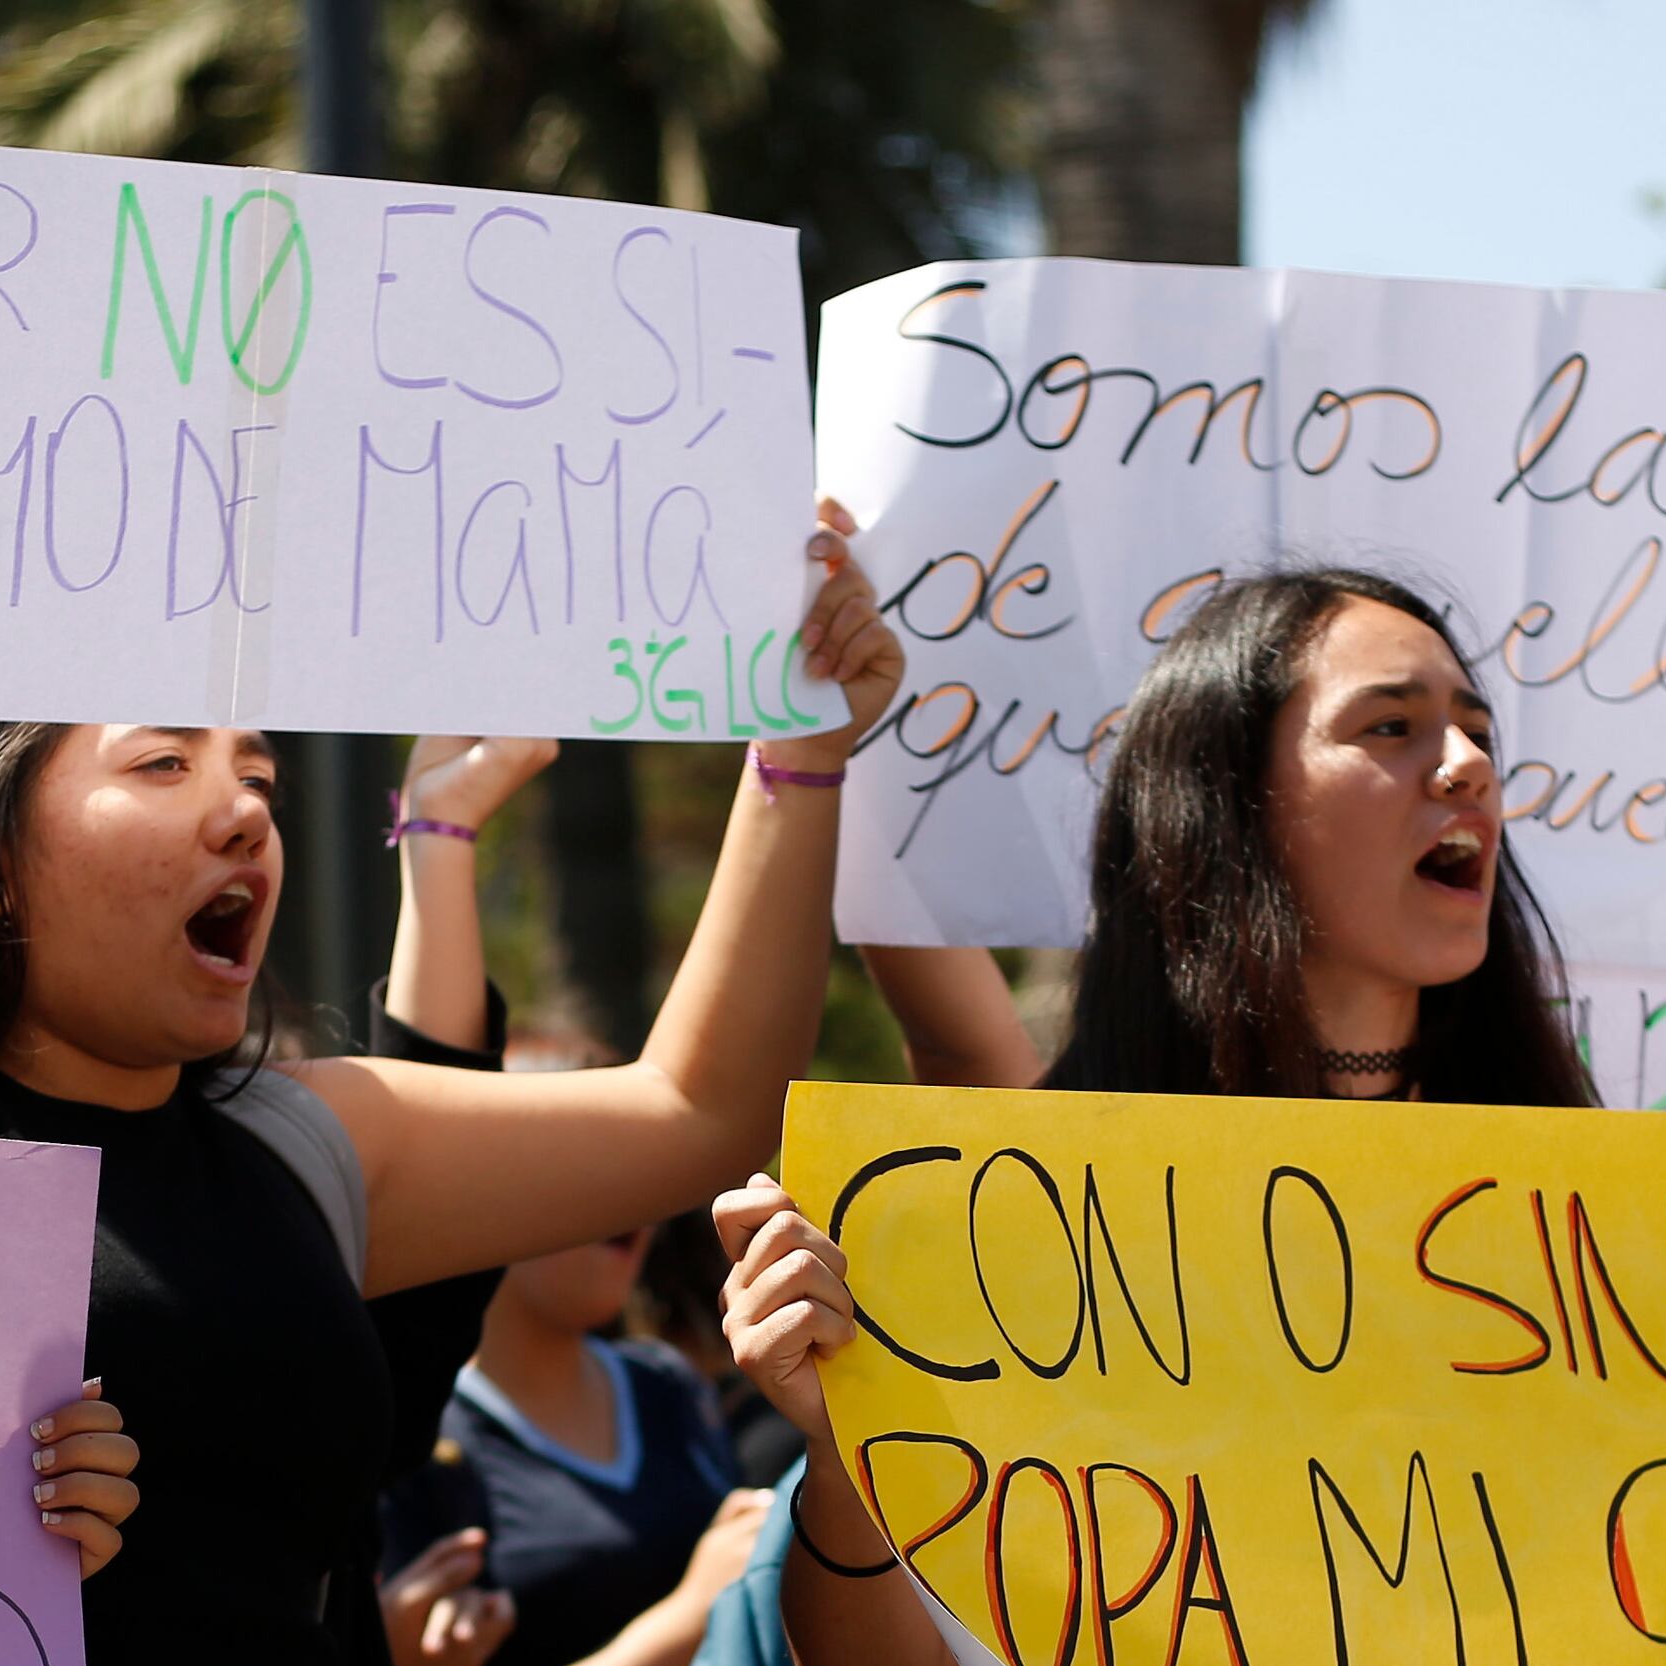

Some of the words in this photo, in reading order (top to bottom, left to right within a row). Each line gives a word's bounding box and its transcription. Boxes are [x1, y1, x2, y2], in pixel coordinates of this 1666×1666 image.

[100, 182, 313, 396] NO
[373, 204, 565, 409] ES
[893, 280, 1442, 482] Somos
[165, 416, 279, 620] DE
[880, 479, 1077, 641] de
[828, 1144, 1192, 1387] CON
[1261, 1163, 1354, 1376] O
